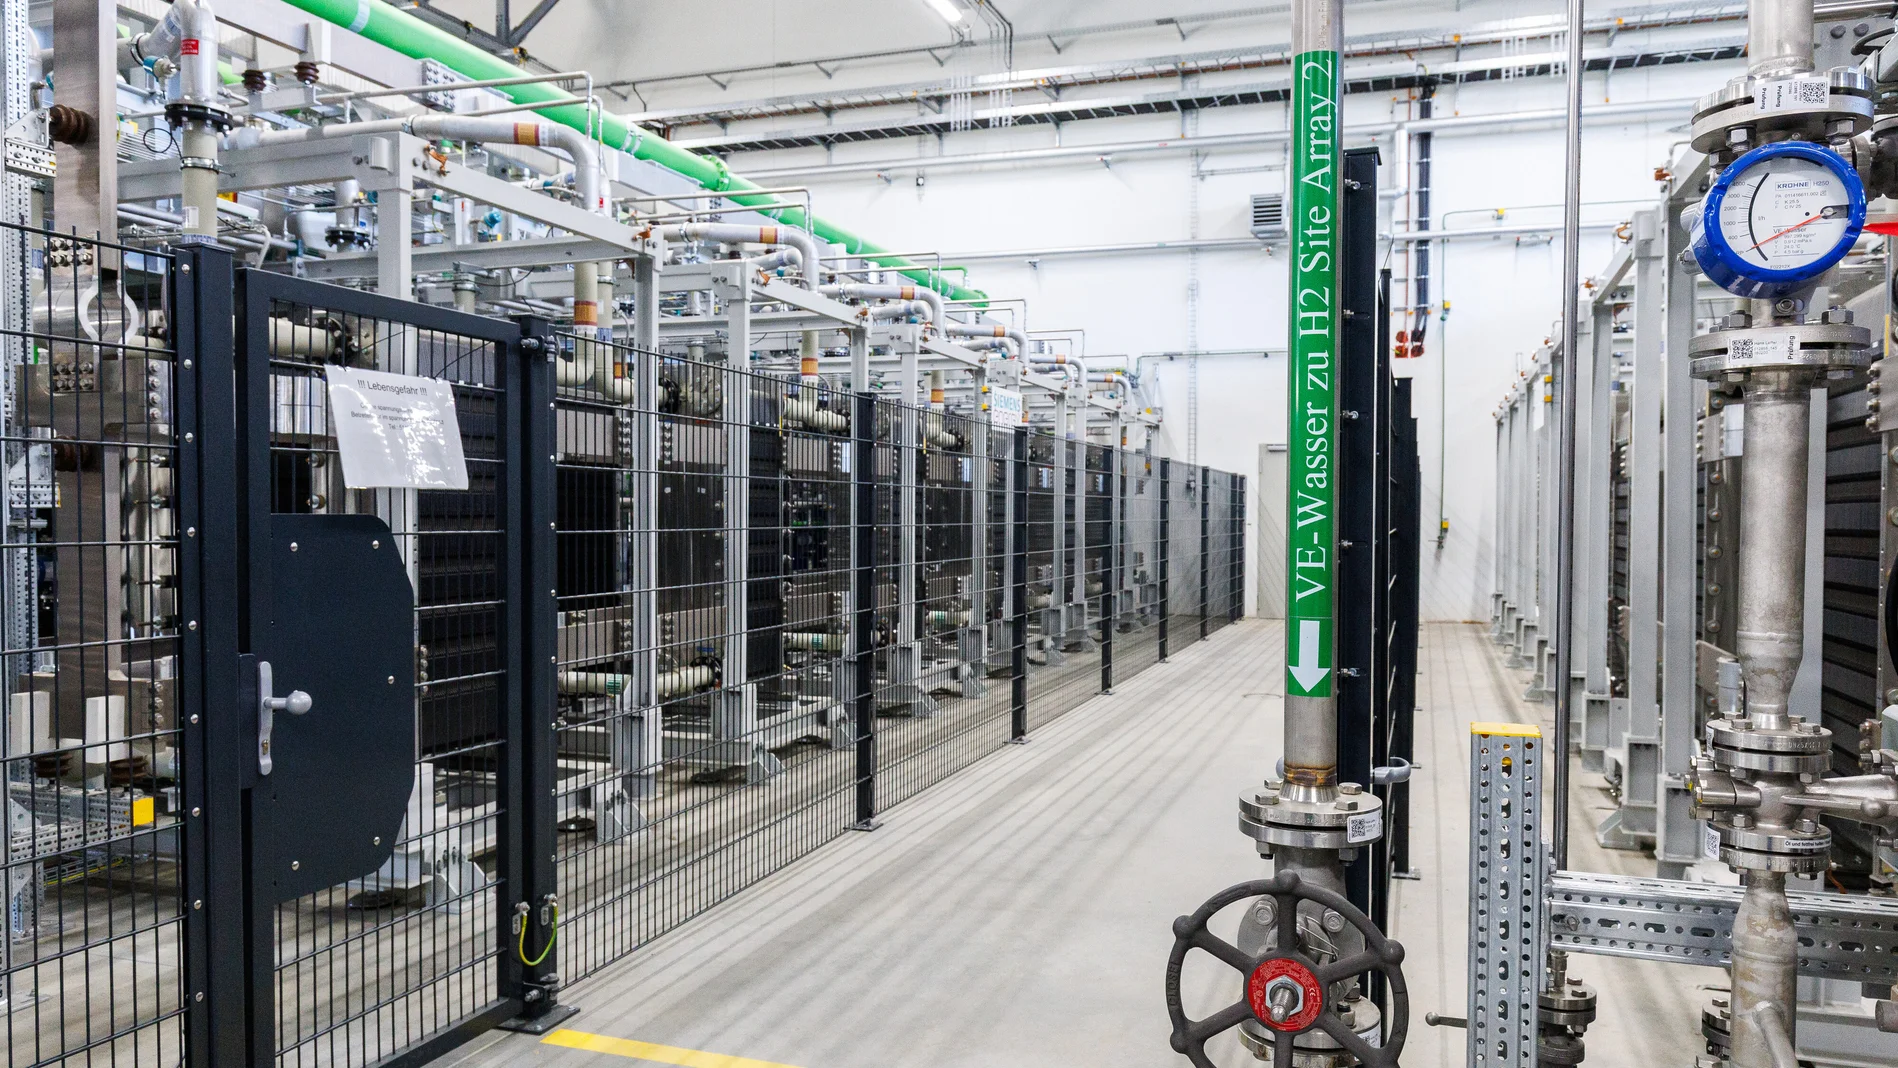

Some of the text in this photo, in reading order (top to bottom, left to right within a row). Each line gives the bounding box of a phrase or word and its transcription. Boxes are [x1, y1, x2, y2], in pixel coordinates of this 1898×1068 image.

[1295, 57, 1338, 602] VE-Wasser zu H2 Site Array 2
[367, 381, 418, 395] Lebensgefahr
[994, 391, 1021, 412] SIEMENS
